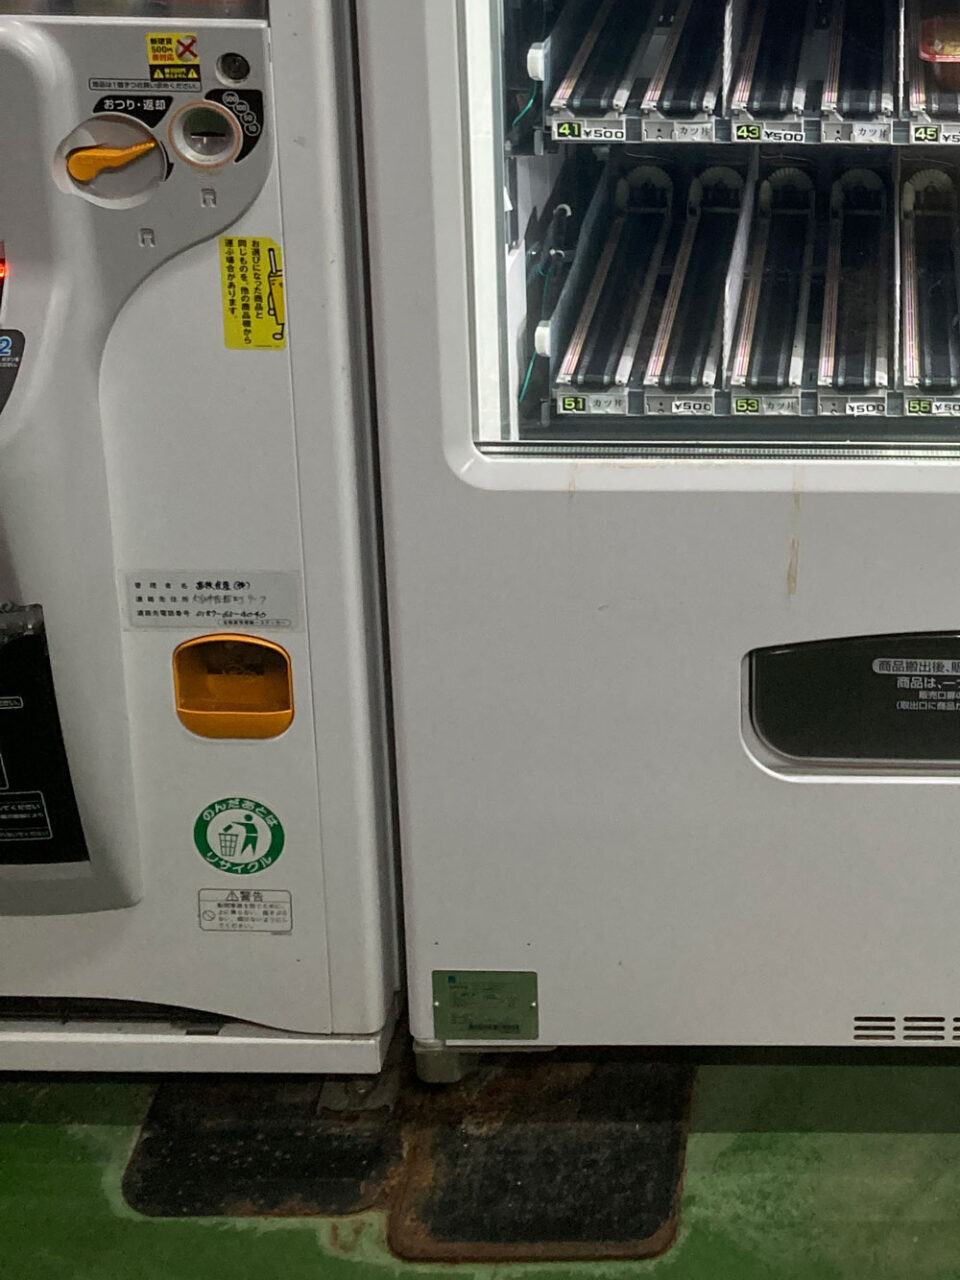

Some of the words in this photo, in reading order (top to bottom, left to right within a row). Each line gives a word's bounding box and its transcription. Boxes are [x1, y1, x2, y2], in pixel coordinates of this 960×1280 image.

[104, 99, 166, 110] おつり・返却
[559, 123, 580, 136] 41
[584, 130, 624, 138] ¥500
[737, 126, 759, 138] 43
[765, 131, 803, 142] ¥500
[915, 128, 936, 140] 45
[565, 398, 584, 409] 51
[674, 402, 711, 411] ¥500
[736, 400, 758, 411] 53
[848, 404, 885, 413] ¥500
[909, 401, 930, 412] 55
[202, 799, 279, 827] のんだあとは
[205, 851, 272, 874] リサイクル
